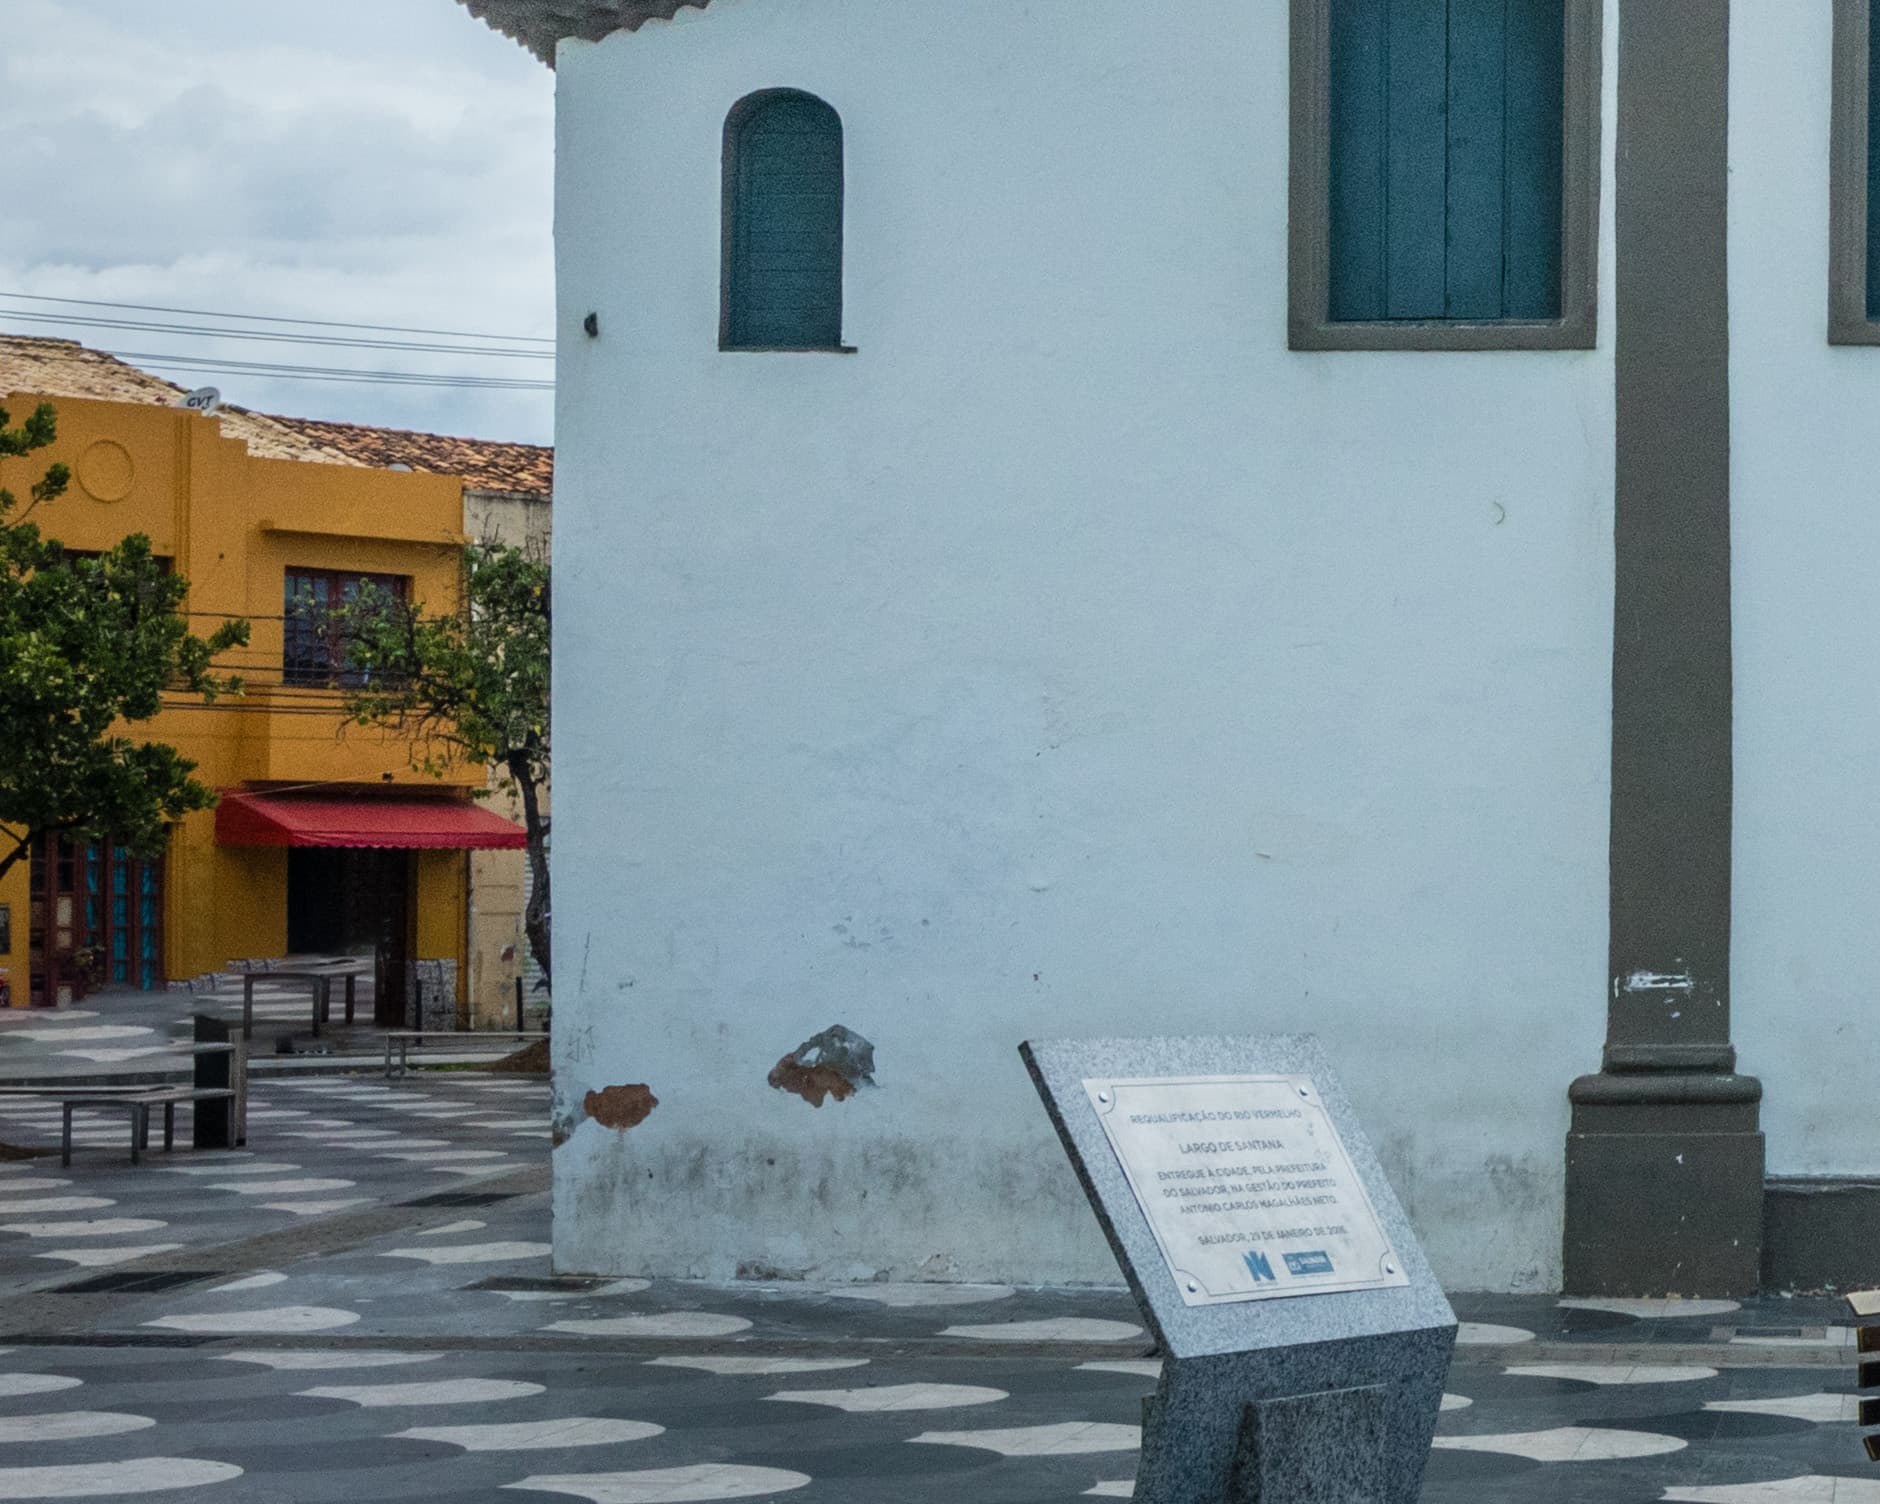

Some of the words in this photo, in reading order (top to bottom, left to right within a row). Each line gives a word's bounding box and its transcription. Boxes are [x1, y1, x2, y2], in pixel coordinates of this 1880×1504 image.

[187, 395, 214, 410] GVT
[1217, 1111, 1233, 1121] DO
[1233, 1110, 1251, 1120] RIO
[1254, 1109, 1302, 1119] VERMELHO
[1179, 1142, 1217, 1154] LARGO
[1218, 1141, 1235, 1152] DE
[1234, 1139, 1284, 1151] SANTANA
[1157, 1169, 1206, 1181] ENTREGUE
[1252, 1165, 1275, 1175] PELA
[1275, 1162, 1327, 1173] PREFEITURA
[1163, 1188, 1178, 1198] DO
[1231, 1183, 1246, 1193] NA
[1245, 1179, 1280, 1193] GESTÃO
[1281, 1181, 1296, 1191] DO
[1296, 1178, 1337, 1189] PREFEITO
[1222, 1200, 1259, 1212] CARLOS
[1261, 1230, 1276, 1240] DE
[1276, 1227, 1313, 1239] JANEIRO
[1313, 1226, 1328, 1236] DE
